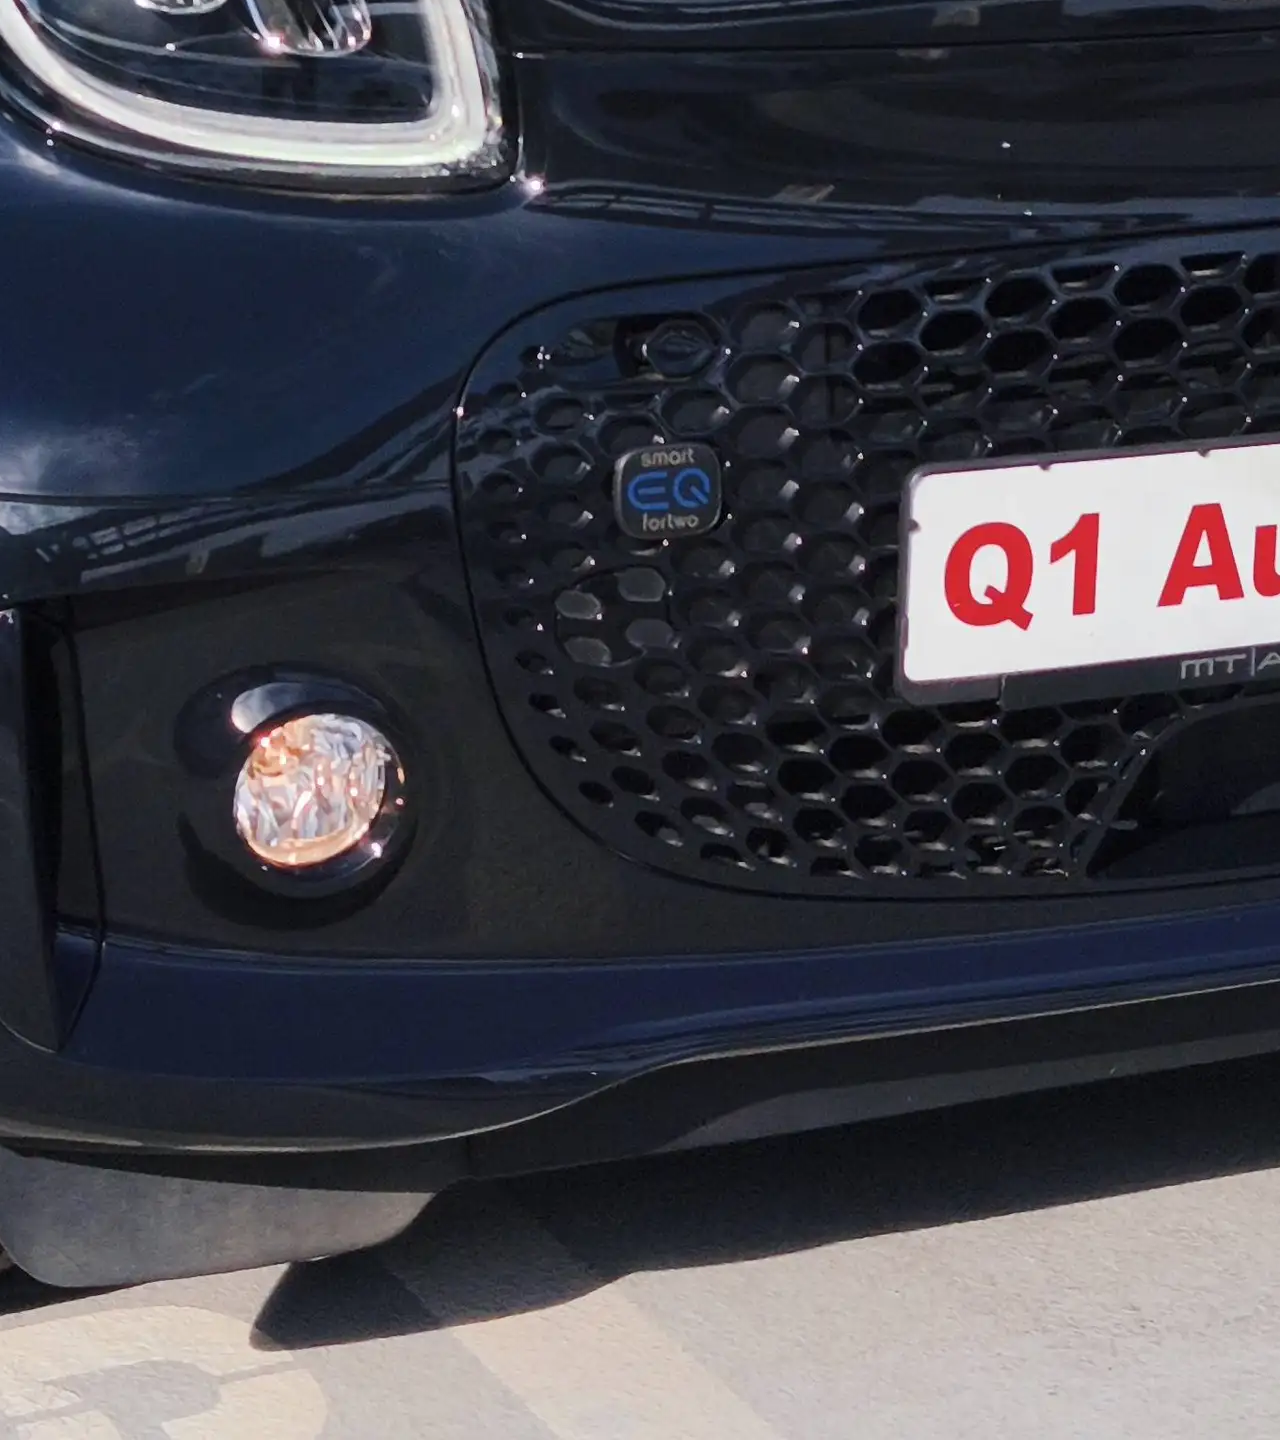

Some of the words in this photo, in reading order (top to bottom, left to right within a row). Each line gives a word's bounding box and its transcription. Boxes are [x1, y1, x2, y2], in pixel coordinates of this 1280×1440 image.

[641, 448, 695, 467] smart
[627, 467, 710, 511] EQ
[944, 513, 1101, 630] Q1
